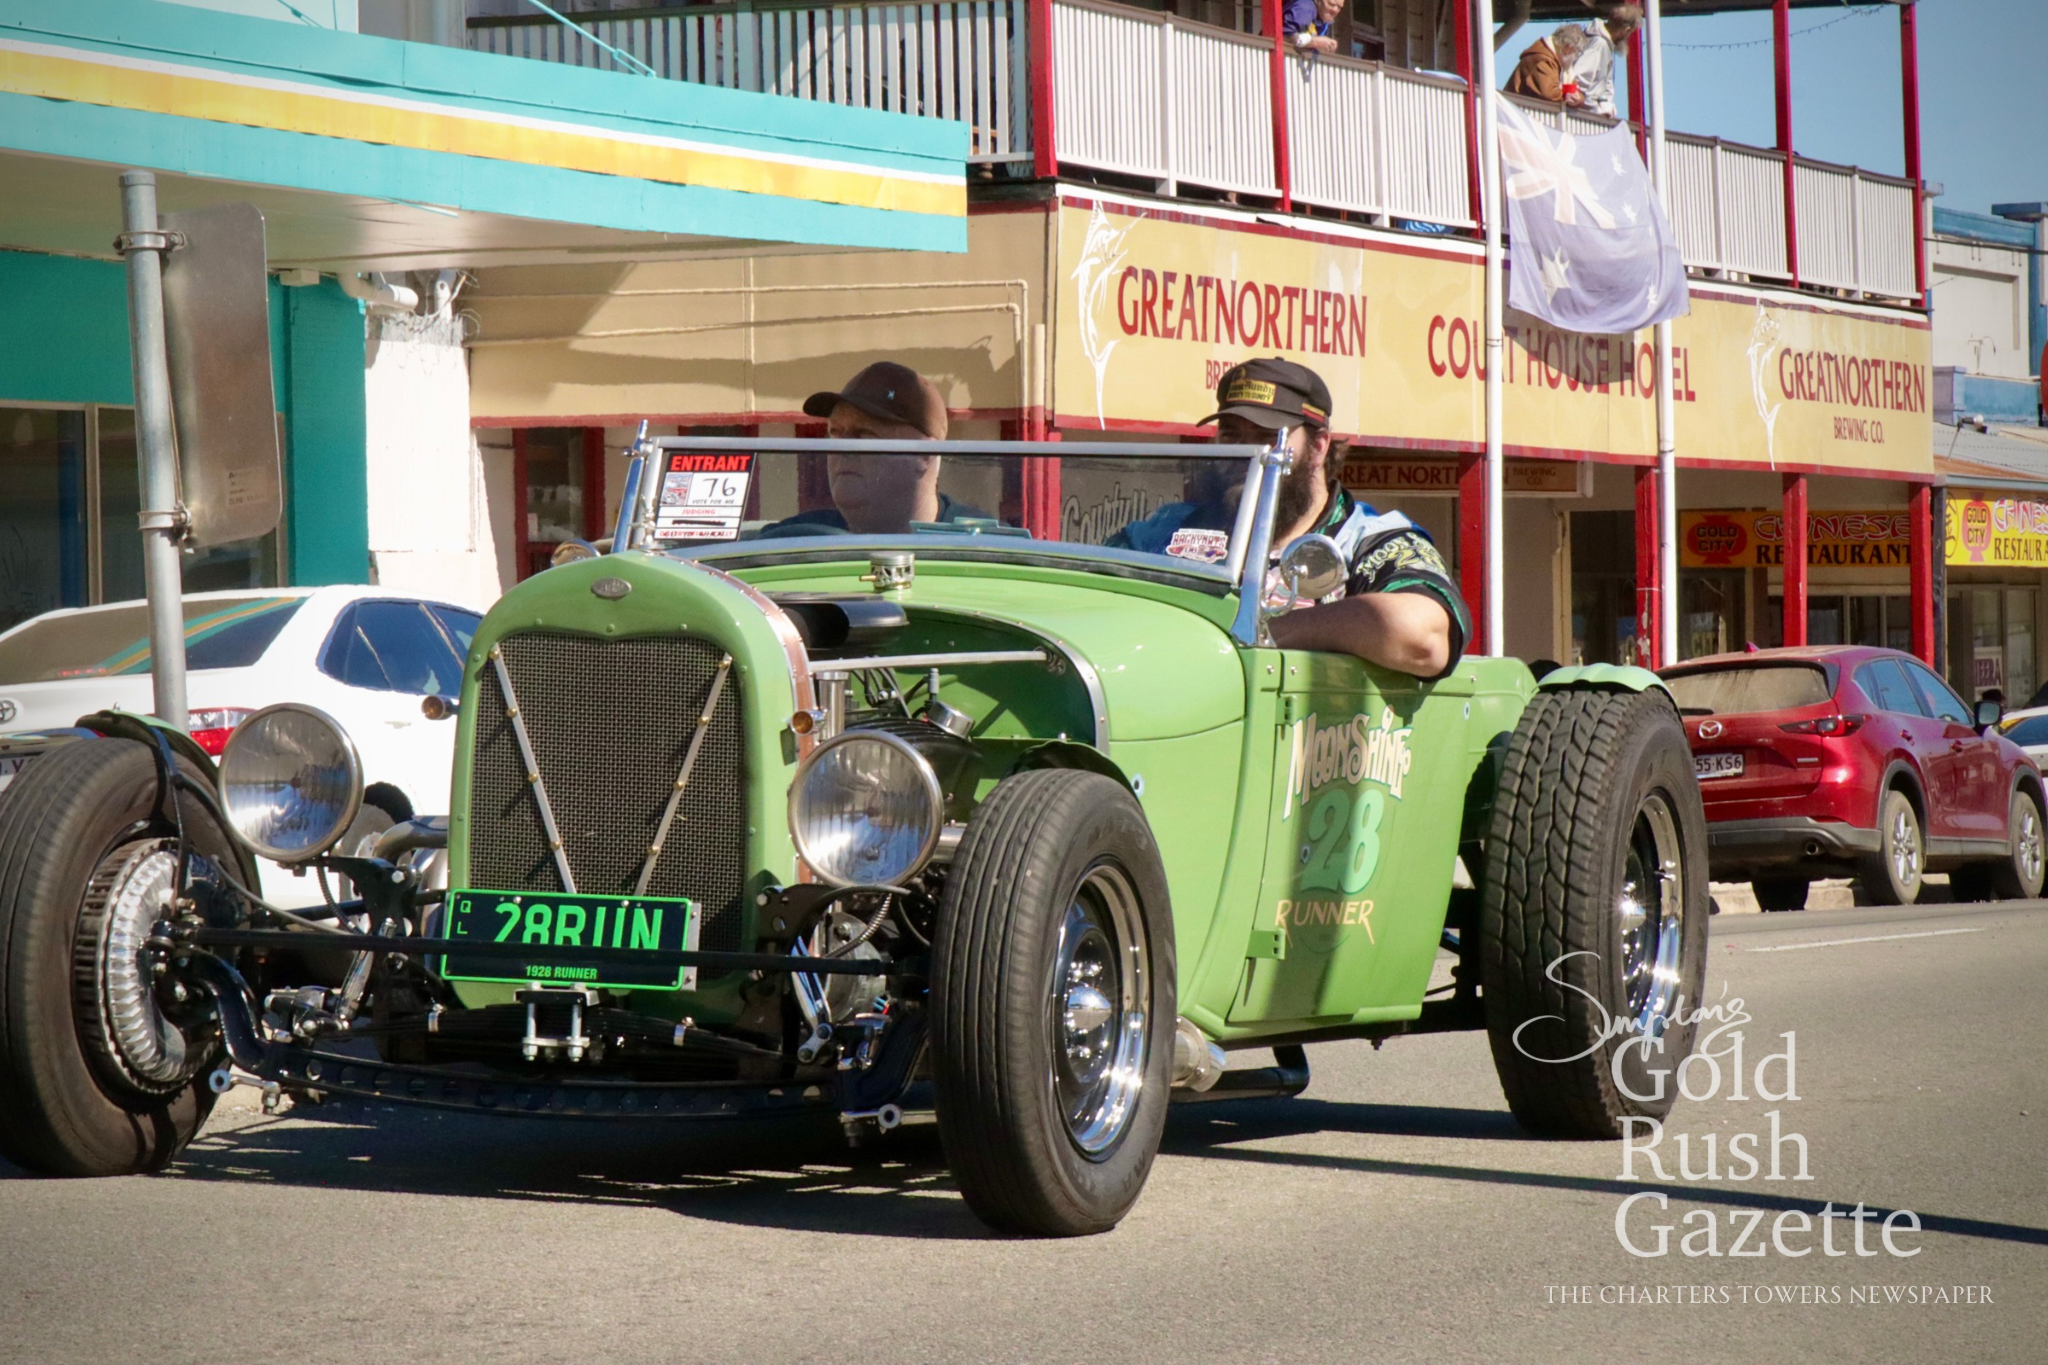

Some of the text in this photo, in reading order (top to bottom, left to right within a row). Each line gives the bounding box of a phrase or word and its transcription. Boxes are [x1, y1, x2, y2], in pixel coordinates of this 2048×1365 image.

[1428, 314, 1696, 402] COUT HOUSE HOEL
[1834, 416, 1868, 443] BREWING
[670, 455, 751, 471] ENTRANT
[1337, 464, 1392, 484] REAT
[703, 477, 737, 498] 76
[1967, 507, 1987, 523] GOLD
[1696, 525, 1738, 538] GOLD
[1967, 528, 1986, 544] CITY
[1698, 540, 1735, 552] CITY
[1756, 544, 1911, 564] RETAURANT
[1301, 788, 1386, 896] 28
[1275, 899, 1375, 948] RUNNER
[525, 965, 597, 980] 1928 RUNNER
